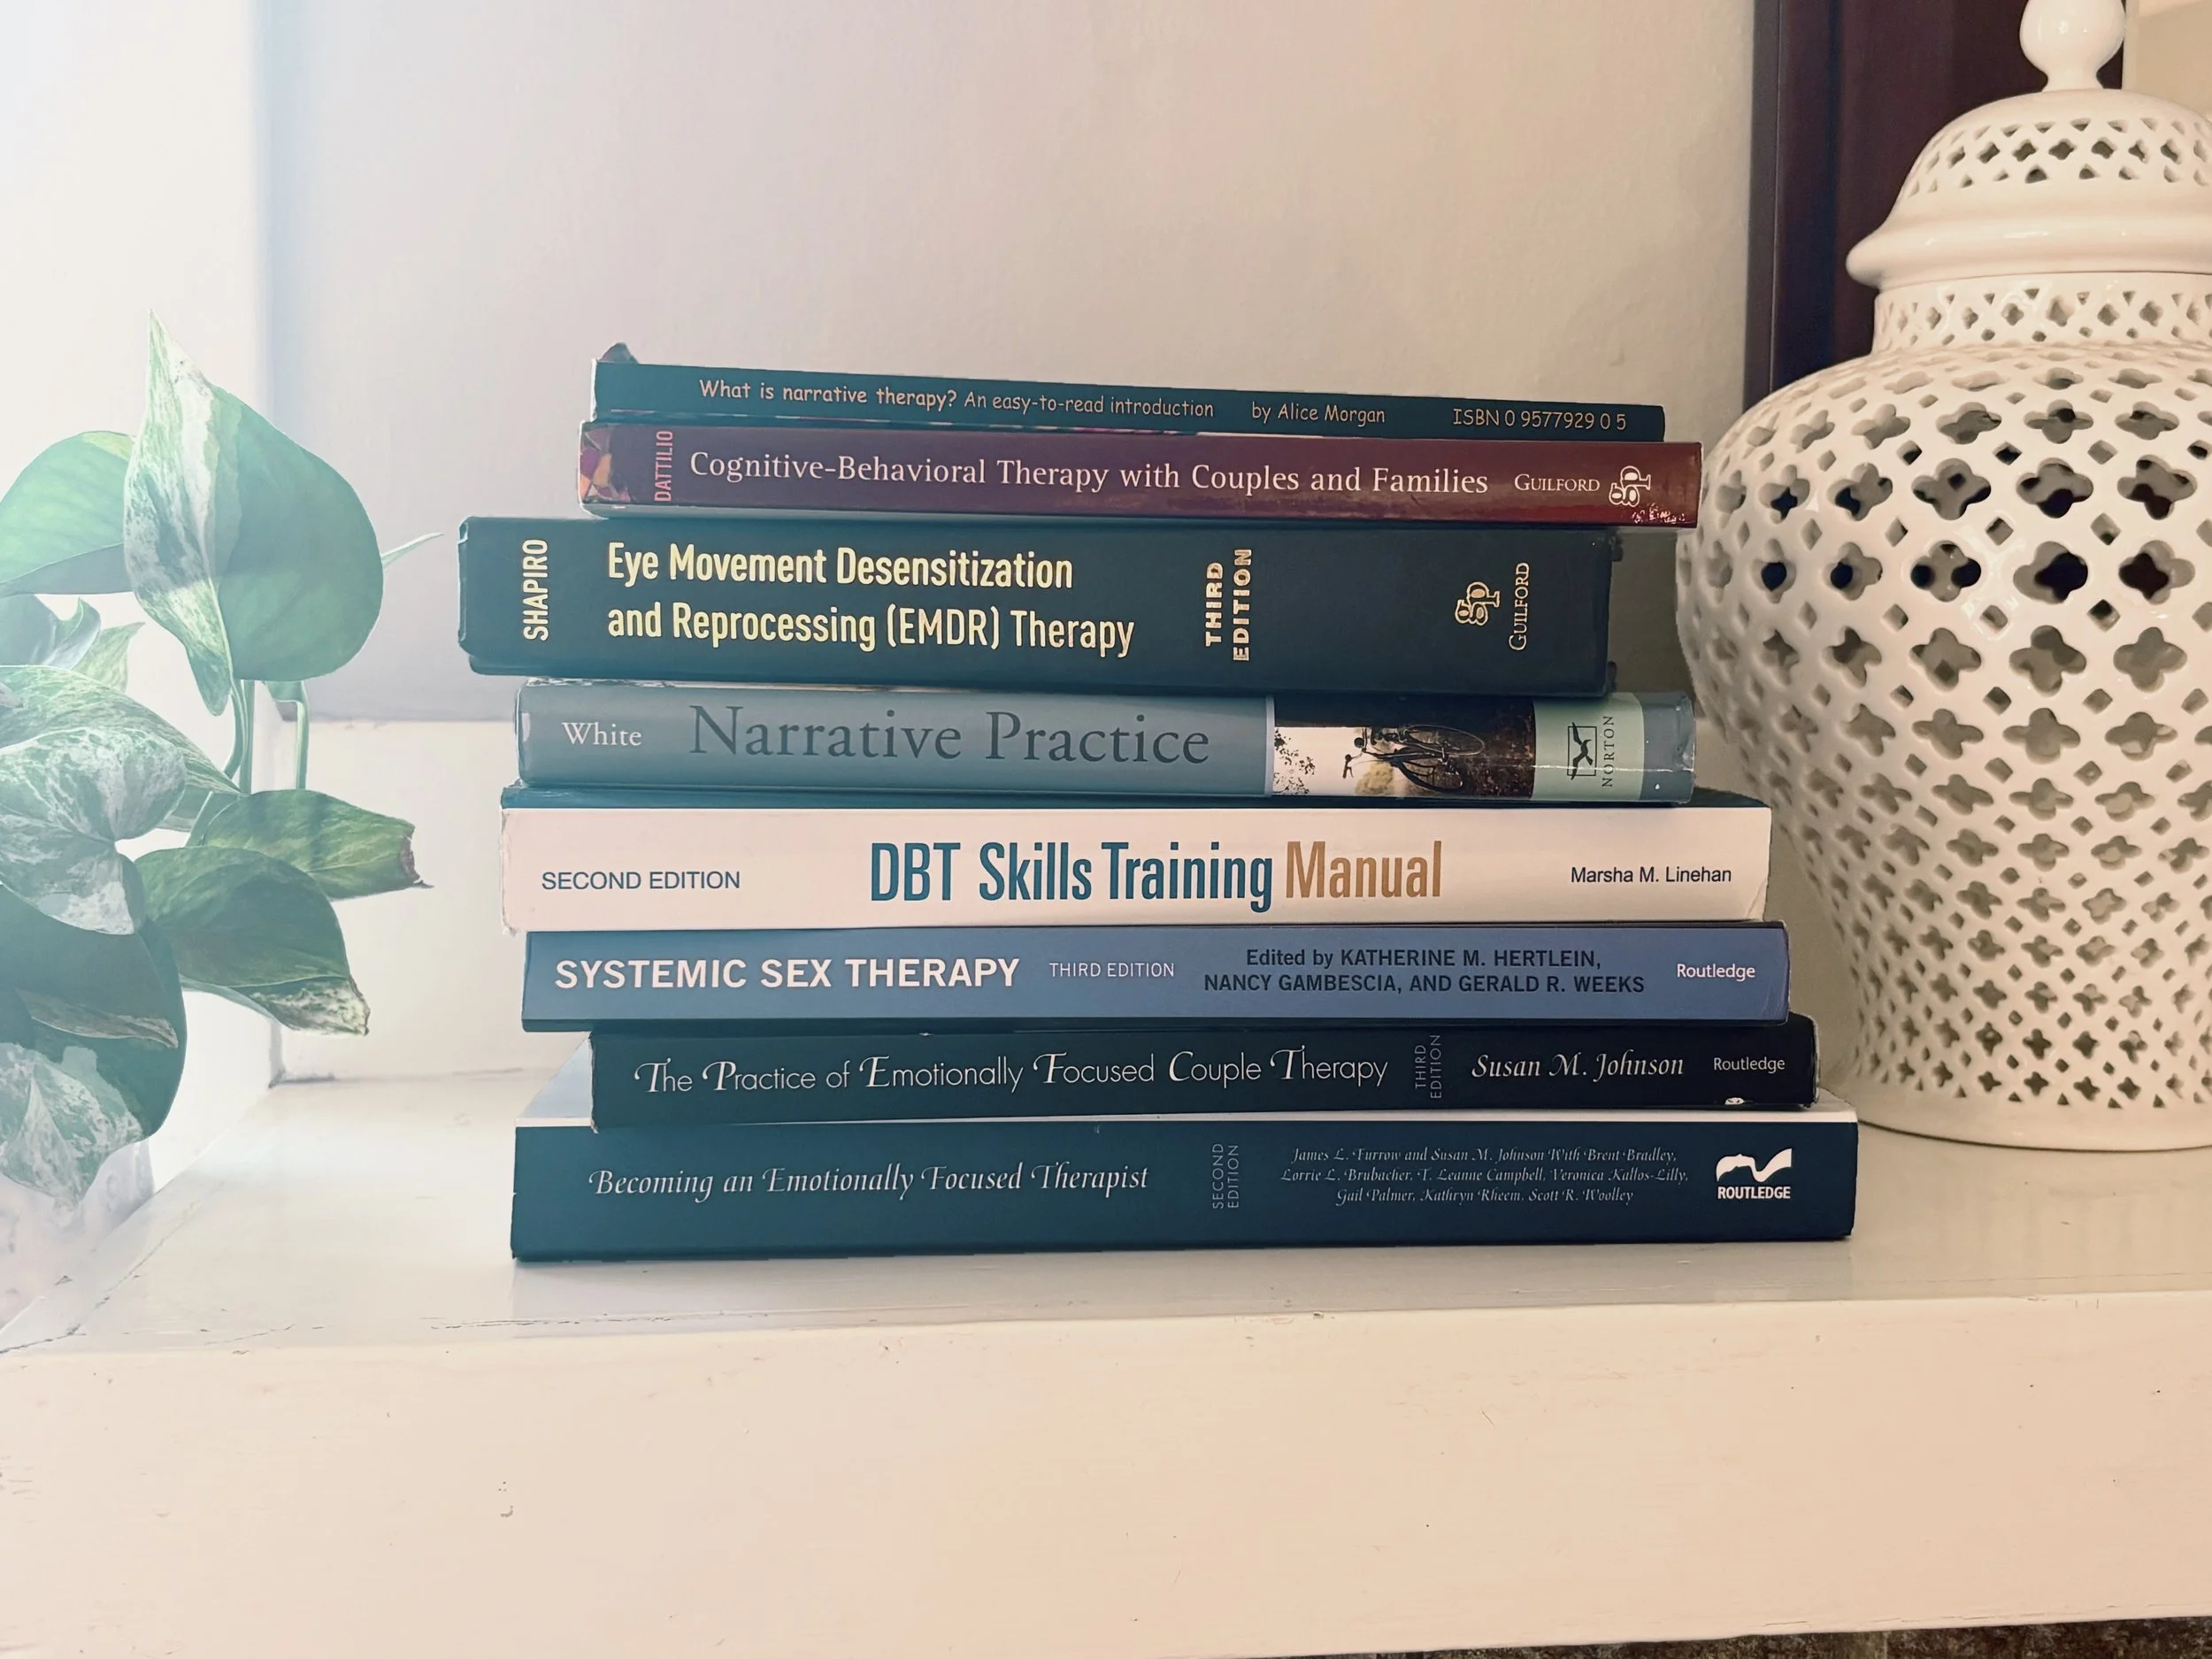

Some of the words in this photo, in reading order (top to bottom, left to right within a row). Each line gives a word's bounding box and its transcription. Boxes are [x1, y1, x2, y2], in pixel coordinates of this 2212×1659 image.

[699, 379, 751, 398] What
[760, 381, 774, 400] is
[783, 385, 867, 403] narrative
[875, 386, 957, 412] therapy?
[964, 391, 987, 409] An
[992, 395, 1104, 416] easy-to-read
[1110, 397, 1214, 418] introduction
[1252, 401, 1271, 424] by
[1277, 402, 1319, 420] Alice
[1324, 403, 1386, 427] Morgan
[1453, 408, 1500, 426] ISBN
[1504, 410, 1516, 426] 0
[1520, 411, 1594, 430] 9577929
[1600, 412, 1611, 430] 0
[1617, 413, 1626, 430] 5
[654, 430, 673, 502] DATTILIO
[690, 451, 986, 483] Cognitive-Behavioral
[996, 459, 1110, 494] Therapy
[1120, 463, 1180, 488] with
[1192, 464, 1300, 495] Couples
[1310, 466, 1362, 492] and
[1372, 467, 1488, 494] Families
[609, 541, 659, 588] Eye
[669, 542, 827, 583] Movement
[836, 547, 1072, 588] Desensitization
[521, 539, 549, 641] SHAPIRO
[1205, 562, 1224, 647] THIRD
[1233, 549, 1252, 662] EDITION
[608, 601, 662, 638] and
[672, 603, 876, 652] Reprocessing
[887, 605, 1000, 650] (EMDR)
[1010, 610, 1135, 658] Therapy
[561, 721, 642, 747] White
[688, 704, 962, 759] Narrative
[985, 711, 1209, 764] Practice
[1601, 716, 1615, 787] NORTON
[541, 871, 642, 890] SECOND
[649, 871, 741, 889] EDITION
[871, 841, 962, 902] DBT
[979, 841, 1092, 902] Skills
[1101, 841, 1273, 913] Training
[1286, 840, 1442, 899] Manual
[1571, 866, 1633, 883] Marsha
[1640, 866, 1659, 883] M.
[1665, 865, 1732, 883] Linehan
[555, 959, 747, 989] SYSTEMIC
[760, 958, 833, 988] SEX
[844, 958, 1020, 987] THERAPY
[1048, 962, 1102, 978] THIRD
[1107, 962, 1174, 978] EDITION
[1247, 949, 1308, 966] Edited
[1312, 949, 1334, 970] by
[1340, 949, 1455, 967] KATHERINE
[1463, 949, 1486, 967] M.
[1494, 949, 1601, 970] HERTLEIN,
[1677, 963, 1755, 982] Routledge
[1204, 973, 1272, 991] NANCY
[1278, 974, 1402, 995] GAMBESCIA,
[1409, 974, 1452, 992] AND
[1458, 974, 1540, 993] GERALD
[1547, 975, 1566, 993] R.
[1573, 975, 1645, 993] WEEKS
[634, 1057, 693, 1093] The
[702, 1061, 816, 1091] Practice
[826, 1060, 850, 1088] of
[859, 1056, 1024, 1094] Emotionally
[1033, 1051, 1155, 1084] Focused
[1169, 1050, 1262, 1089] Couple
[1270, 1044, 1388, 1087] Therapy
[1414, 1045, 1427, 1089] THIRD
[1429, 1034, 1442, 1099] EDITION
[1471, 1054, 1540, 1078] Susan
[1548, 1054, 1587, 1077] M.
[1593, 1048, 1684, 1083] Johnson
[1713, 1056, 1786, 1074] Routledge
[1280, 1168, 1321, 1181] Lorrie
[1325, 1168, 1340, 1181] L.
[1417, 1168, 1432, 1181] T.
[1437, 1168, 1483, 1181] Leanne
[1550, 1168, 1604, 1181] Veronica
[1290, 1148, 1329, 1164] James
[1333, 1148, 1348, 1161] L.
[1352, 1148, 1401, 1161] Furrow
[1405, 1147, 1428, 1161] and
[1431, 1148, 1469, 1161] Susan
[1471, 1148, 1493, 1161] M.
[1495, 1146, 1544, 1164] Johnson
[1548, 1146, 1582, 1161] With
[1584, 1148, 1620, 1162] Brent
[1623, 1147, 1678, 1165] Bradley,
[588, 1170, 714, 1203] Becoming
[723, 1175, 753, 1193] an
[762, 1163, 914, 1201] Emotionally
[920, 1161, 1023, 1190] Focused
[1031, 1163, 1148, 1198] Therapist
[1211, 1143, 1225, 1210] SECOND
[1226, 1145, 1240, 1209] EDITION
[1717, 1186, 1791, 1200] ROUTLEDGE
[1335, 1187, 1363, 1207] Gail
[1420, 1187, 1474, 1205] Kathryn
[1528, 1188, 1559, 1202] Scott
[1562, 1188, 1578, 1202] R.
[1582, 1187, 1633, 1205] Woolley
